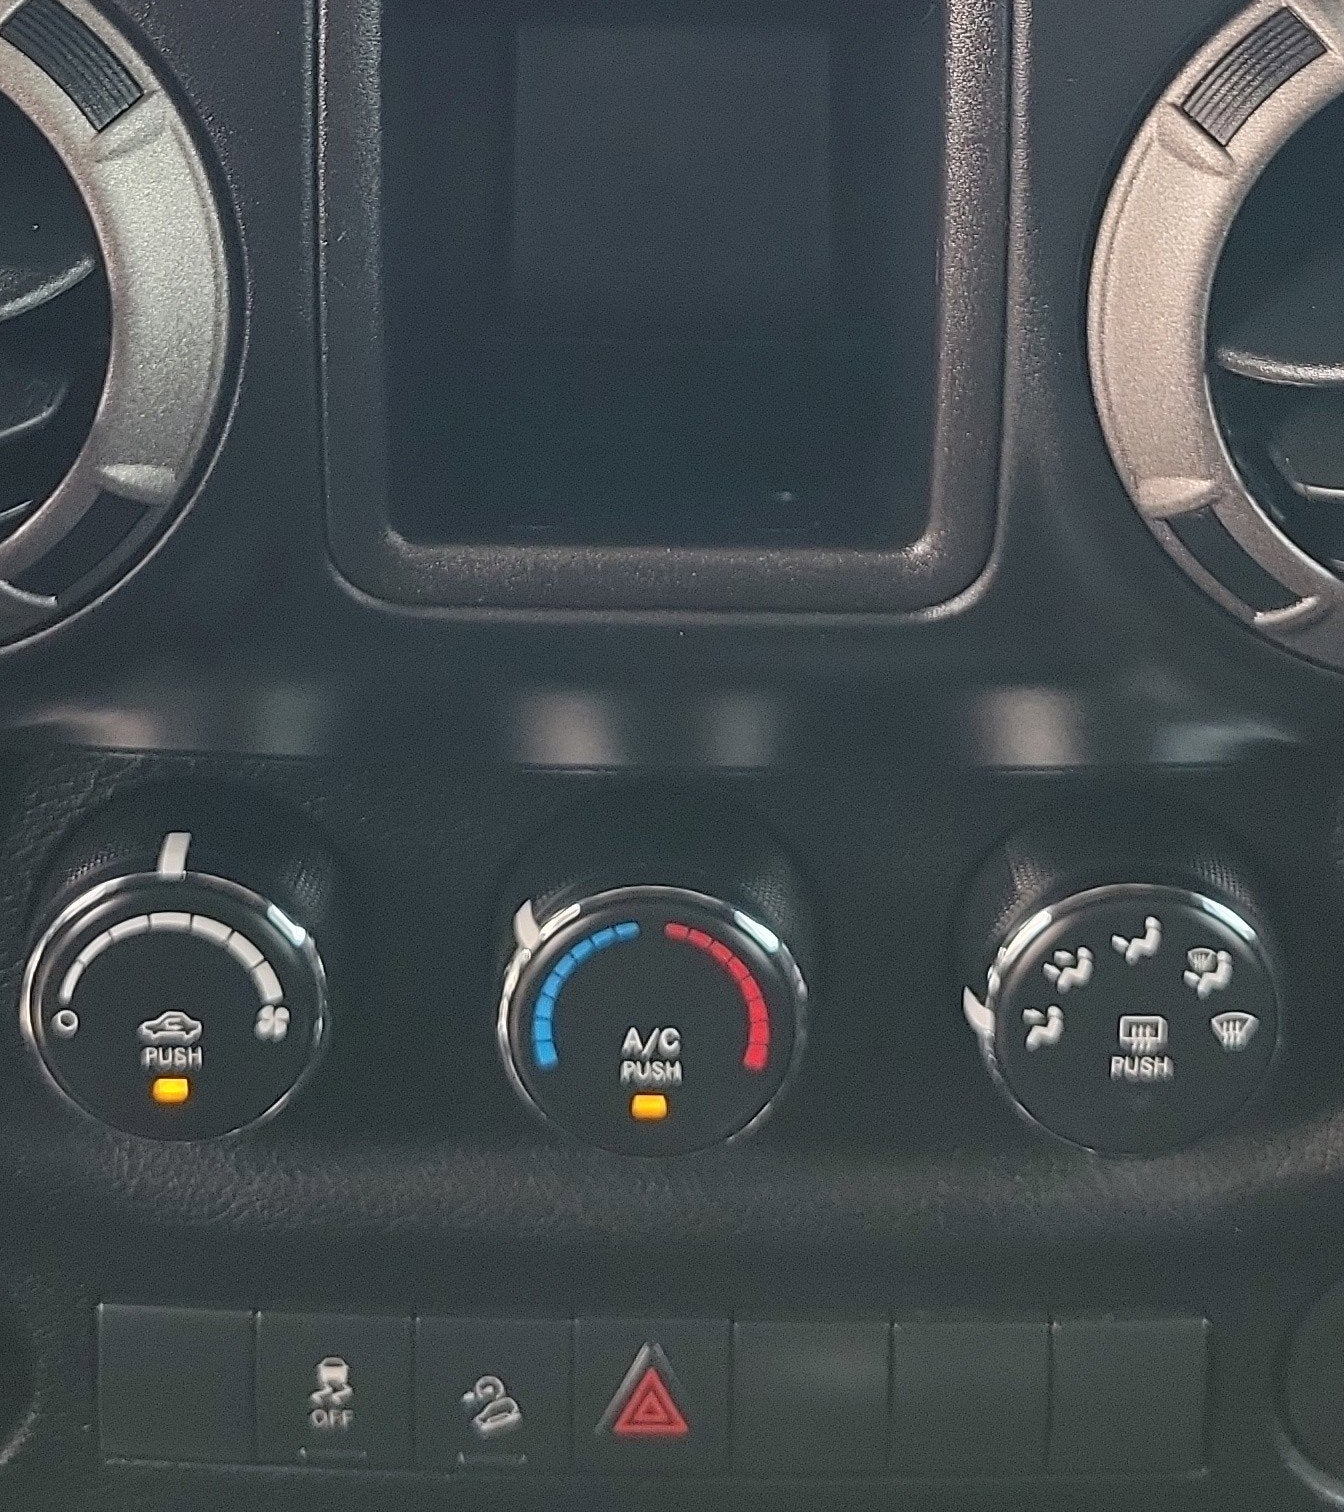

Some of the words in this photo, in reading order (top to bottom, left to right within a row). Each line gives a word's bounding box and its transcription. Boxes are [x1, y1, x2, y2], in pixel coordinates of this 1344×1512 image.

[621, 1026, 682, 1059] A/C
[140, 1046, 203, 1071] PUSH
[1110, 1055, 1174, 1082] PUSH
[619, 1060, 684, 1087] PUSH
[310, 1408, 354, 1430] OFF
